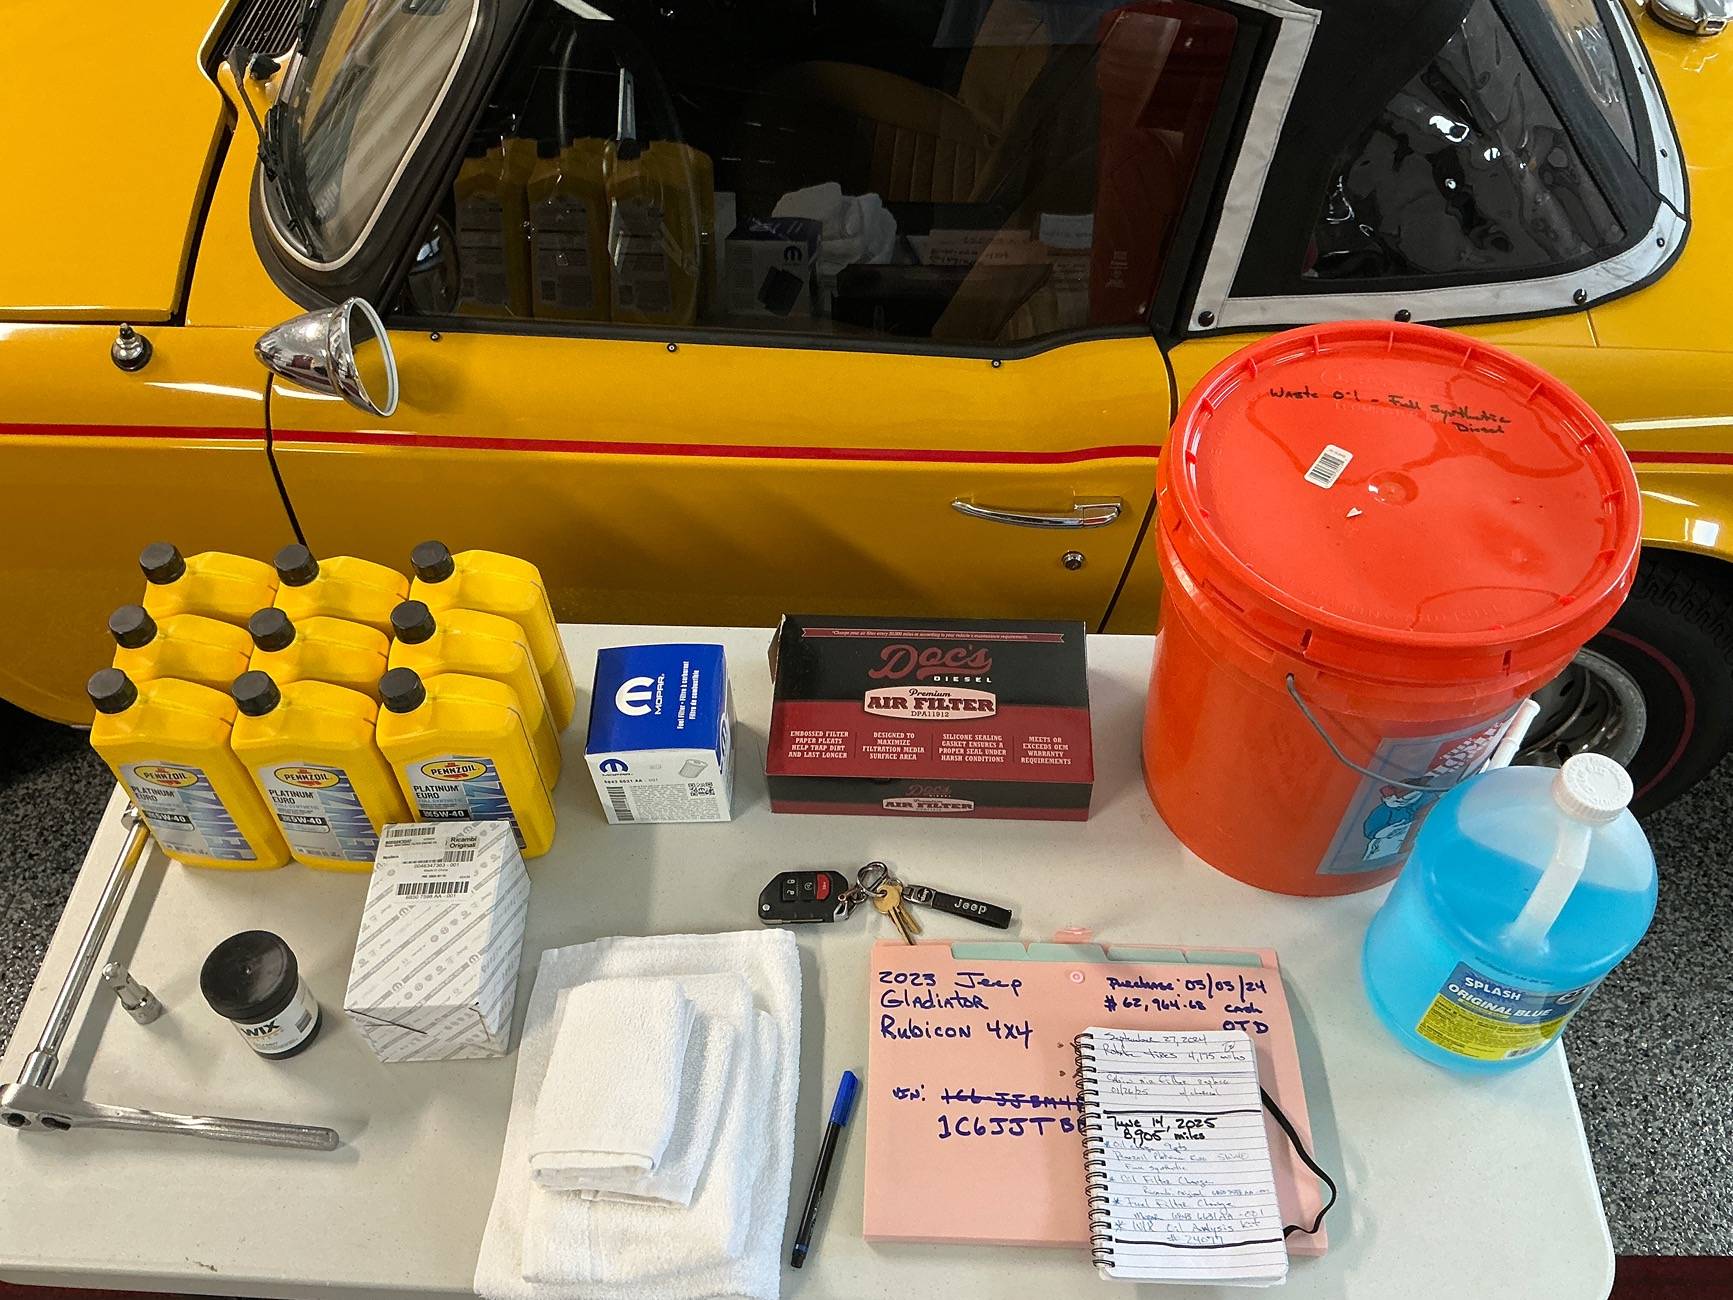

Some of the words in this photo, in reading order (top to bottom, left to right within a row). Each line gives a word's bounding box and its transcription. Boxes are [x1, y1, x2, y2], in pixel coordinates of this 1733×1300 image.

[1388, 394, 1421, 410] Full
[1430, 404, 1511, 424] Synthetic
[868, 644, 992, 680] Doc's
[934, 675, 992, 683] DIESEL
[654, 676, 664, 715] MOPAR
[909, 688, 951, 698] Premium
[868, 696, 909, 710] AIR
[913, 697, 995, 712] FILTER
[1021, 757, 1072, 765] REQUIREMENTS
[284, 773, 328, 781] PENNZOIL
[430, 765, 476, 775] PENNZOIL
[131, 786, 175, 797] PLATINUM
[269, 789, 314, 798] PLATINUM
[954, 899, 988, 915] Jeep
[879, 970, 936, 986] 2023
[954, 972, 1022, 997] Jeep
[1465, 977, 1521, 1000] SPLASH
[1448, 983, 1513, 1016] ORIGINAL
[1513, 1008, 1553, 1017] BLUE
[241, 1020, 280, 1036] WIX
[880, 1014, 971, 1039] Rubicon
[1223, 1020, 1268, 1033] OTD
[893, 1084, 926, 1101] VIN:
[937, 1114, 1083, 1139] 1C6JJTB
[1107, 1115, 1142, 1130] June
[1175, 1117, 1218, 1128] 2025
[1174, 1130, 1206, 1140] miles
